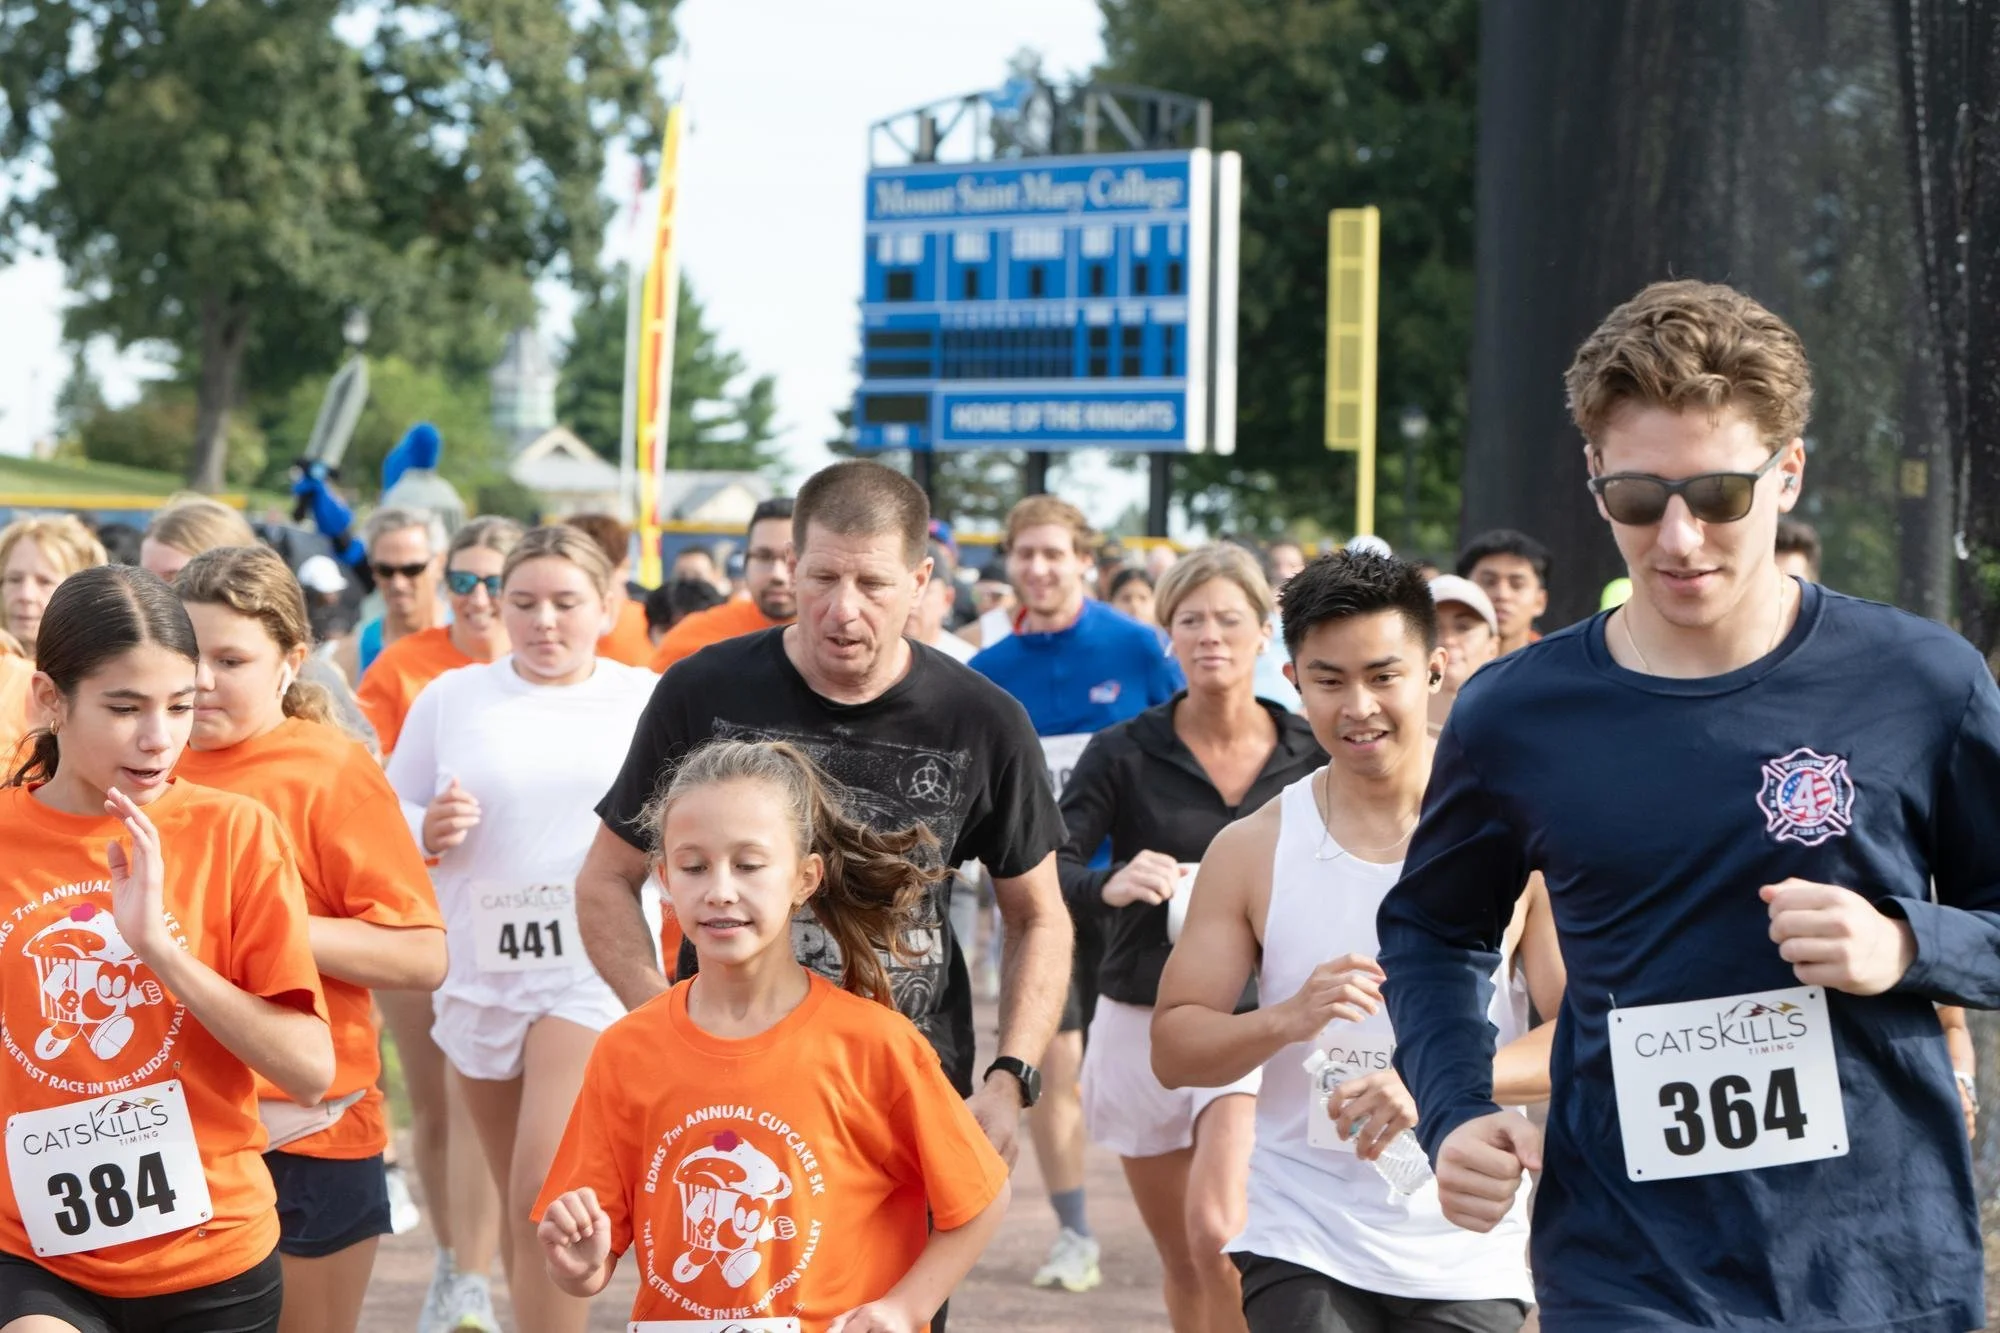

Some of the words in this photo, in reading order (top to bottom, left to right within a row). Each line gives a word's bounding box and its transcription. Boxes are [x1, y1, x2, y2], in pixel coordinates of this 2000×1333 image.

[874, 178, 955, 217] Mount
[956, 174, 1020, 212] Saint
[1020, 171, 1085, 216] Mary
[1087, 168, 1182, 212] College
[951, 402, 1013, 433] HOME
[1013, 402, 1041, 432] OF
[1042, 400, 1081, 432] THE
[1083, 400, 1176, 432] KNIGHTS
[1791, 773, 1819, 818] 4
[11, 900, 39, 921] 7TH
[42, 880, 112, 905] ANNUAL
[480, 888, 571, 910] CATSKILLS
[498, 919, 563, 960] 441
[1634, 1011, 1808, 1058] CATSKILLS
[1748, 1042, 1796, 1055] TIMING
[48, 1075, 85, 1094] RACE
[86, 1082, 104, 1094] IN
[105, 1075, 133, 1093] THE
[23, 1104, 169, 1156] CATSKILLS
[1657, 1066, 1809, 1156] 364
[118, 1130, 160, 1147] TIMING
[644, 1145, 667, 1194] BDMS
[662, 1125, 685, 1146] 7TH
[685, 1104, 755, 1129] ANNUAL
[757, 1112, 818, 1173] CUPCAKE
[807, 1172, 826, 1197] 5K
[46, 1151, 178, 1237] 384
[643, 1217, 655, 1248] THE
[680, 1297, 712, 1321] RACE
[713, 1308, 731, 1321] IN
[731, 1305, 753, 1320] HE
[796, 1218, 824, 1272] VALLEY
